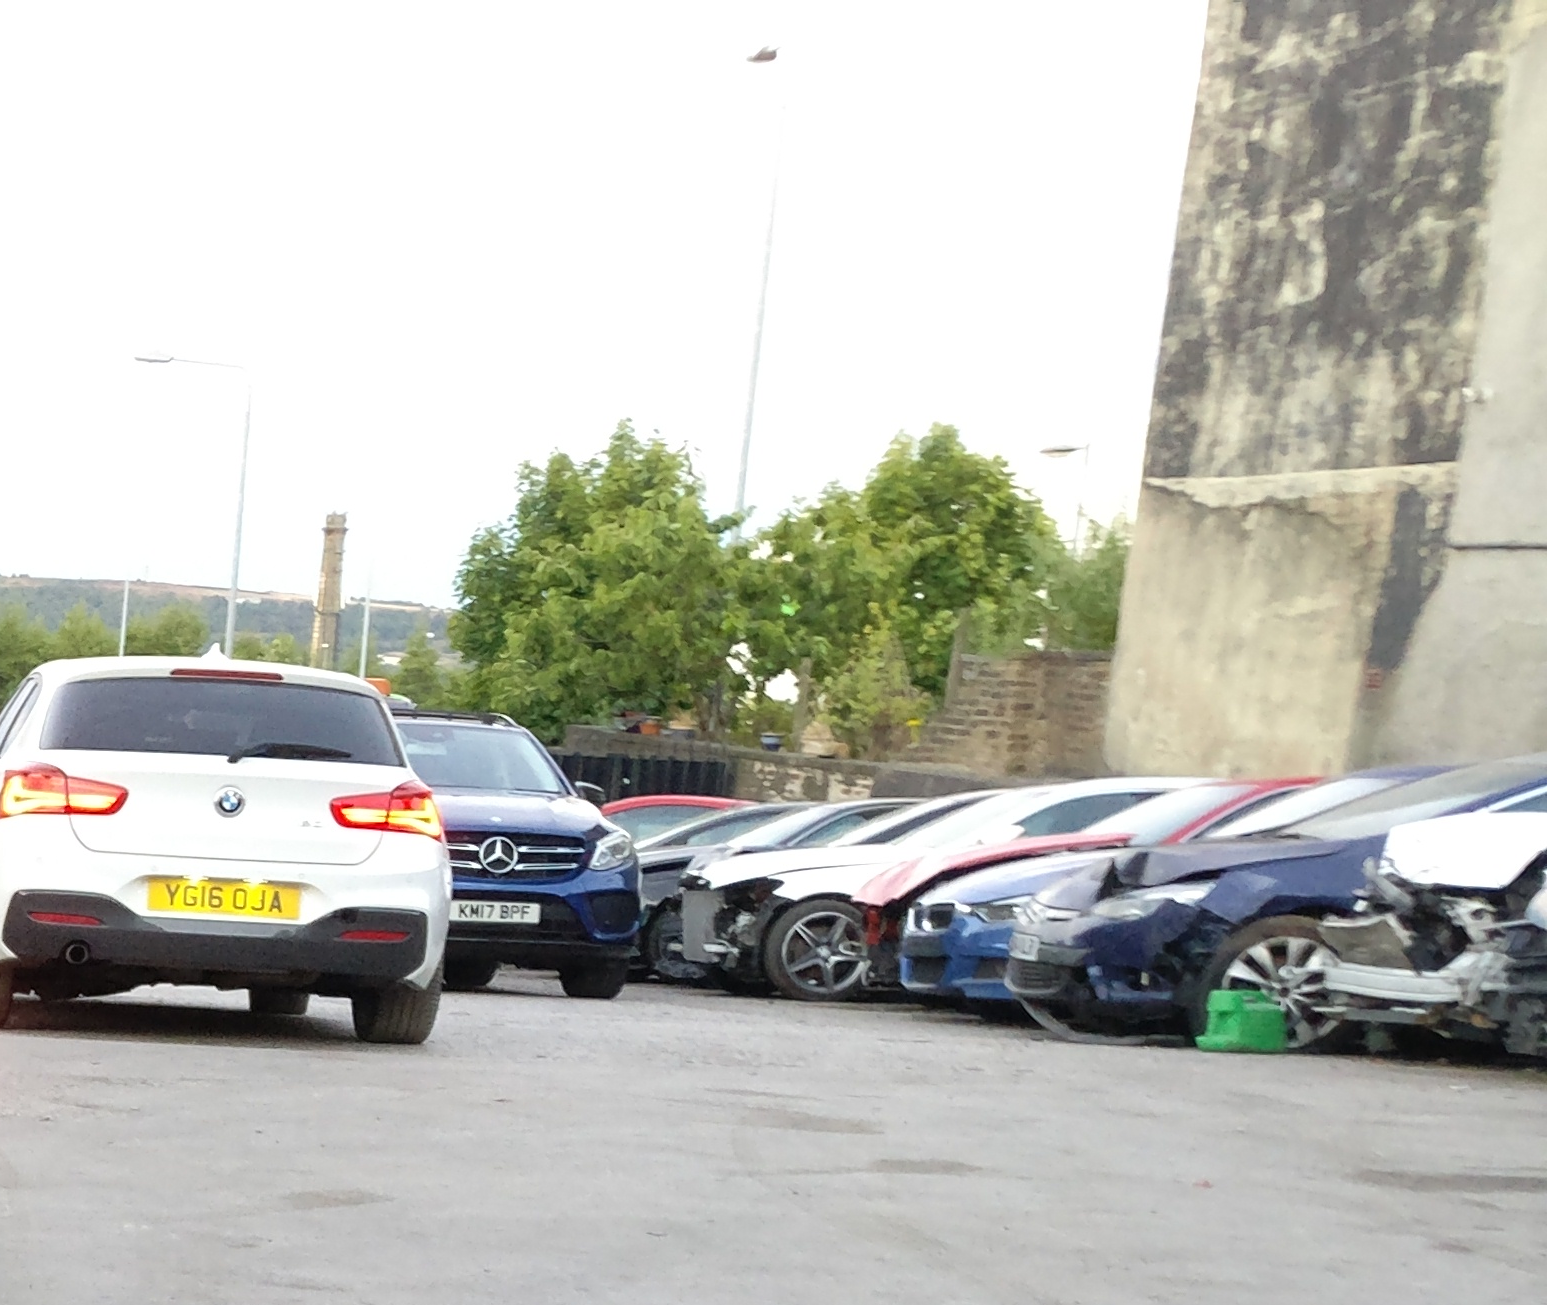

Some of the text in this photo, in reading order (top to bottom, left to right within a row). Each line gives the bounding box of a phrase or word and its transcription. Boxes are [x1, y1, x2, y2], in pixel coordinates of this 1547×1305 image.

[165, 884, 224, 909] YG16
[458, 903, 531, 920] KM17 BPF
